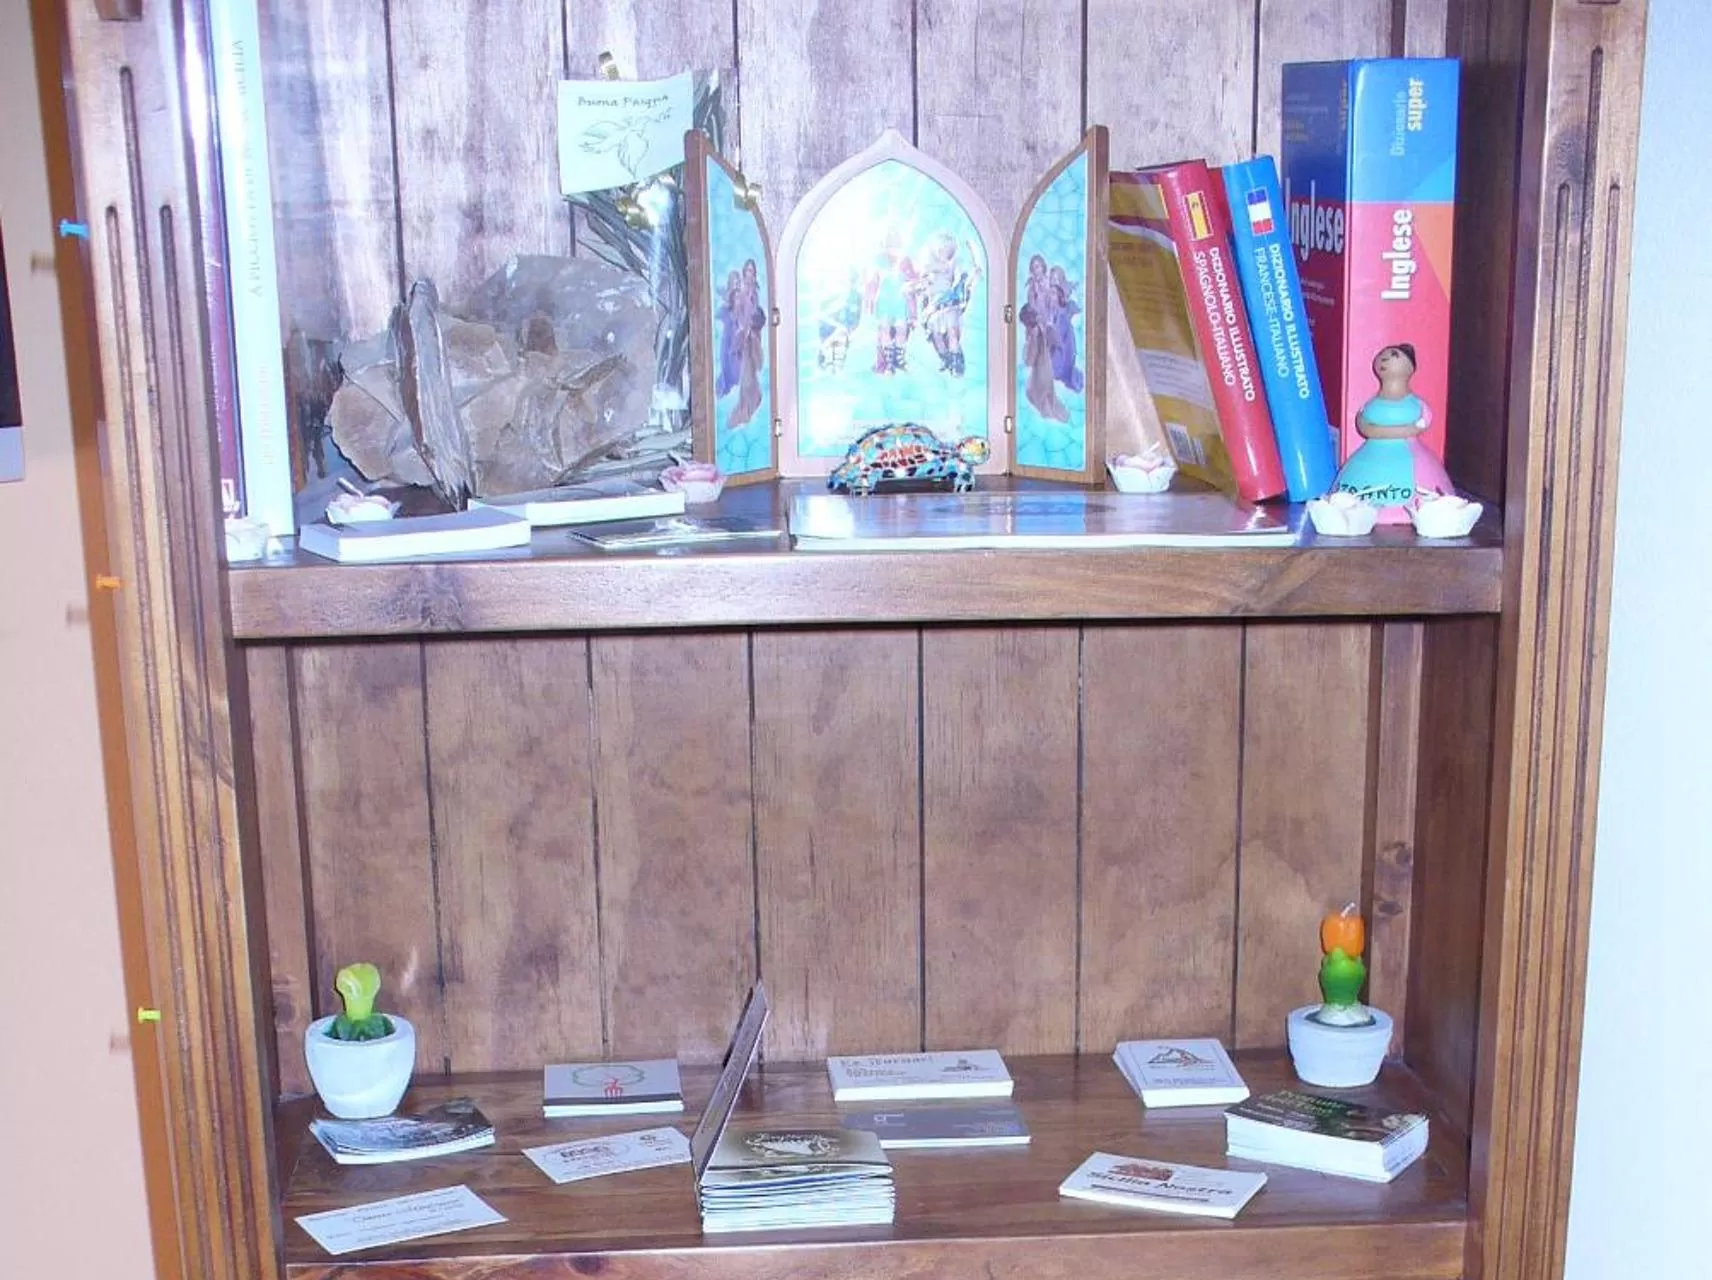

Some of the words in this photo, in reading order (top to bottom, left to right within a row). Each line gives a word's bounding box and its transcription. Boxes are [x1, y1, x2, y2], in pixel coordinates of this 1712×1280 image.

[1408, 77, 1426, 132] super
[1284, 177, 1345, 261] Inglese
[1381, 208, 1416, 301] Inglese
[1193, 251, 1236, 387] SPAGNOLO-ITALIANO
[1210, 247, 1236, 325] DIZIONARIO
[1229, 327, 1256, 402] ILLUSTRATO
[1255, 247, 1290, 379] FRANCESE-ITALIANO
[1269, 243, 1294, 322] DIZIONARIO
[1285, 323, 1310, 400] ILLUSTRATO
